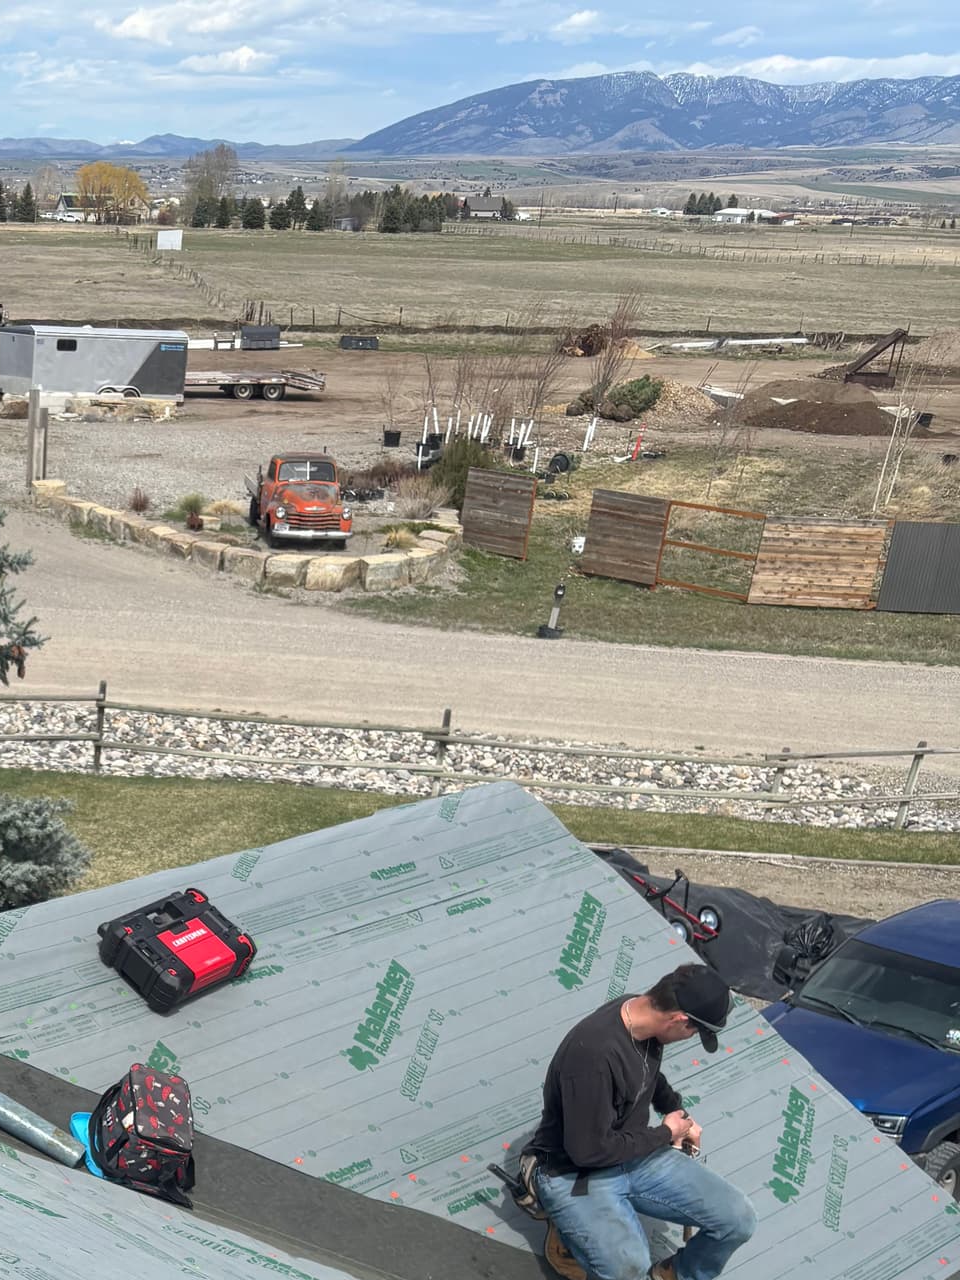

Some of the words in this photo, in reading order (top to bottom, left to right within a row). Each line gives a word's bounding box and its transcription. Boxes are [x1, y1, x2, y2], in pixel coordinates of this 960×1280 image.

[560, 890, 603, 972] Malarkey
[579, 945, 599, 978] Roofing
[353, 958, 411, 1050] Malarkey
[376, 1018, 401, 1056] Roofing
[390, 978, 415, 1021] Products
[400, 1056, 428, 1102] SECURE
[772, 1085, 810, 1181] Malarkey
[800, 1107, 816, 1149] Products
[792, 1146, 812, 1187] Roofing
[823, 1185, 843, 1232] SECURE
